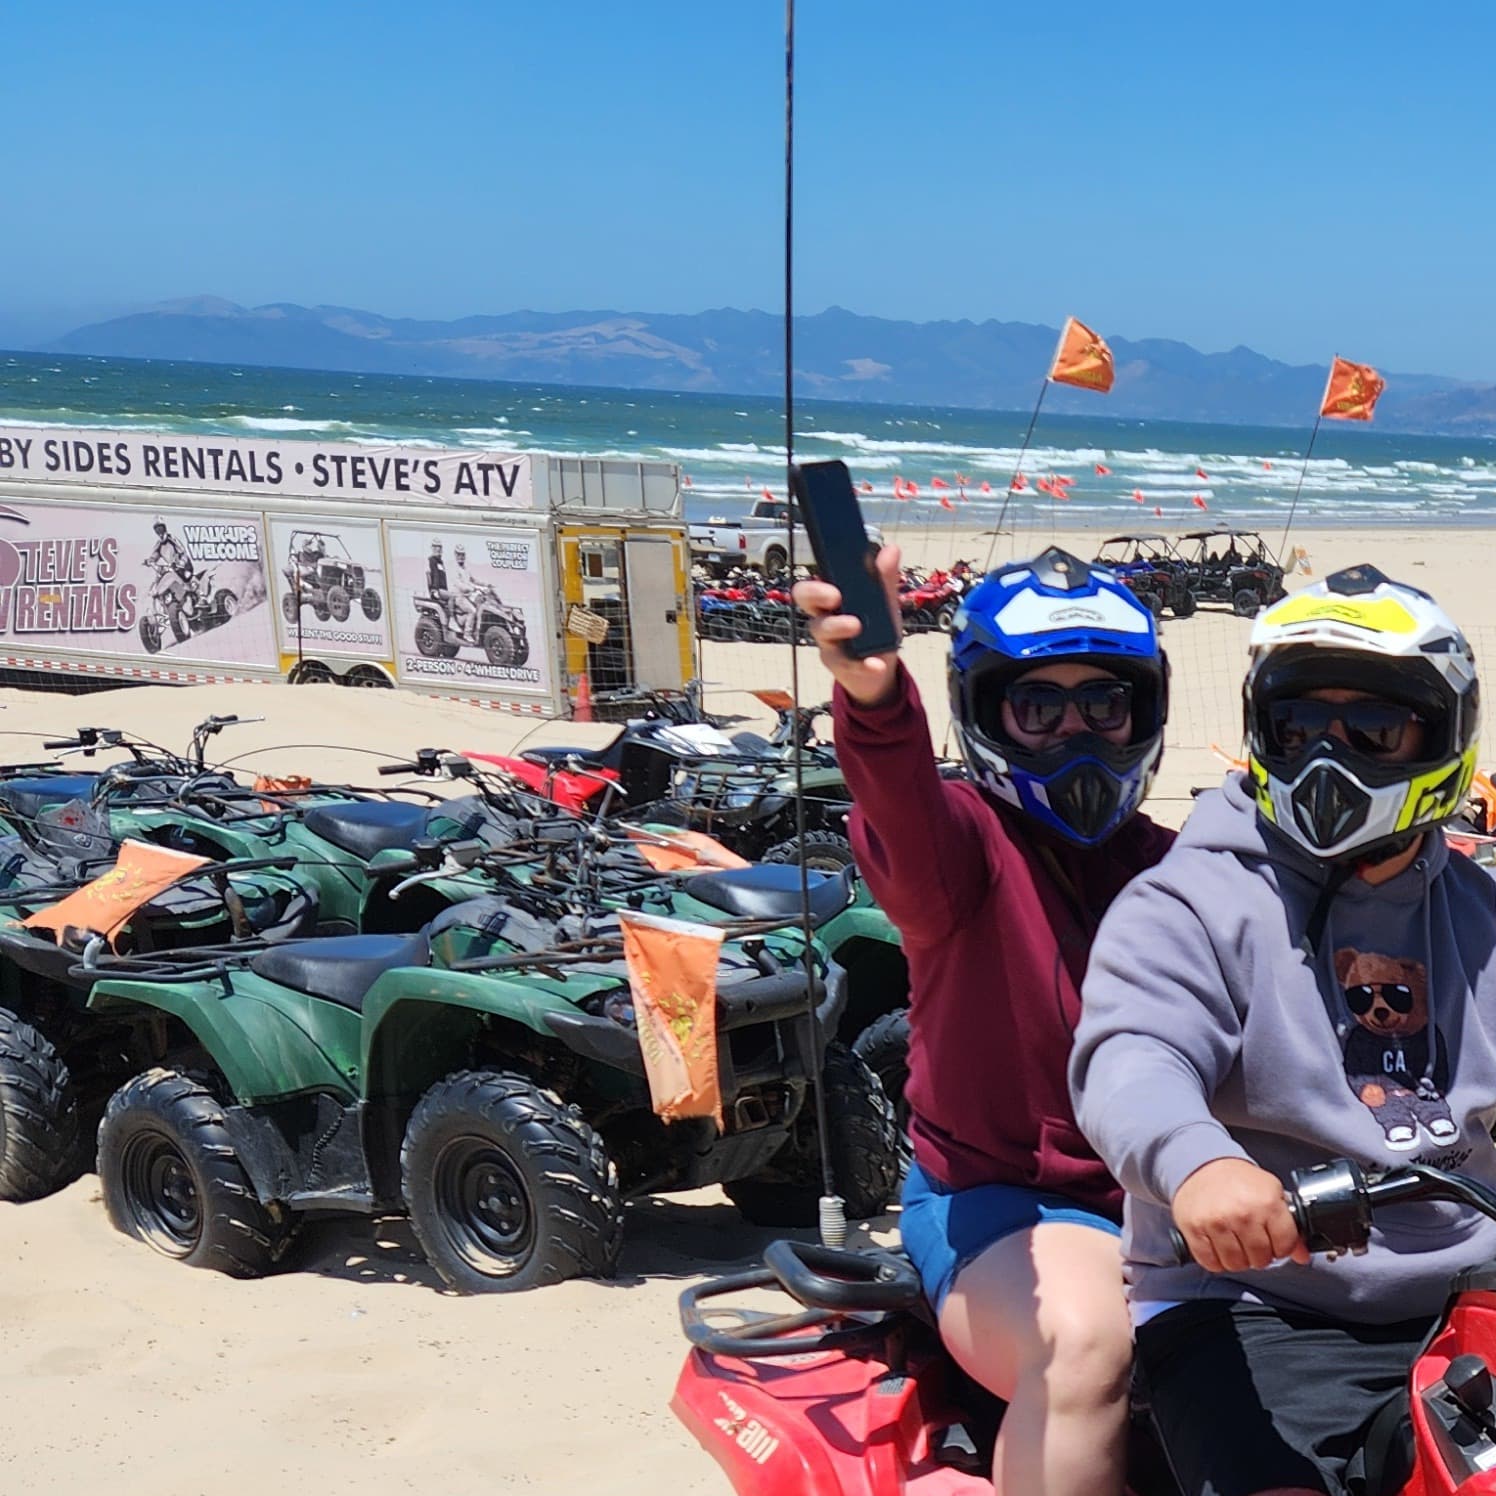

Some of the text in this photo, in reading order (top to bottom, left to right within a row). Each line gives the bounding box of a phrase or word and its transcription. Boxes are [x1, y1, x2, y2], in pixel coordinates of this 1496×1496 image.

[0, 438, 521, 498] BY SIDES RENTALS STEVE'S ATV
[183, 525, 257, 544] WALK-UPS
[187, 543, 259, 562] WELCOME
[16, 583, 137, 633] RENTALS
[406, 658, 456, 675] 2-PERSON
[509, 667, 541, 682] DRIVE
